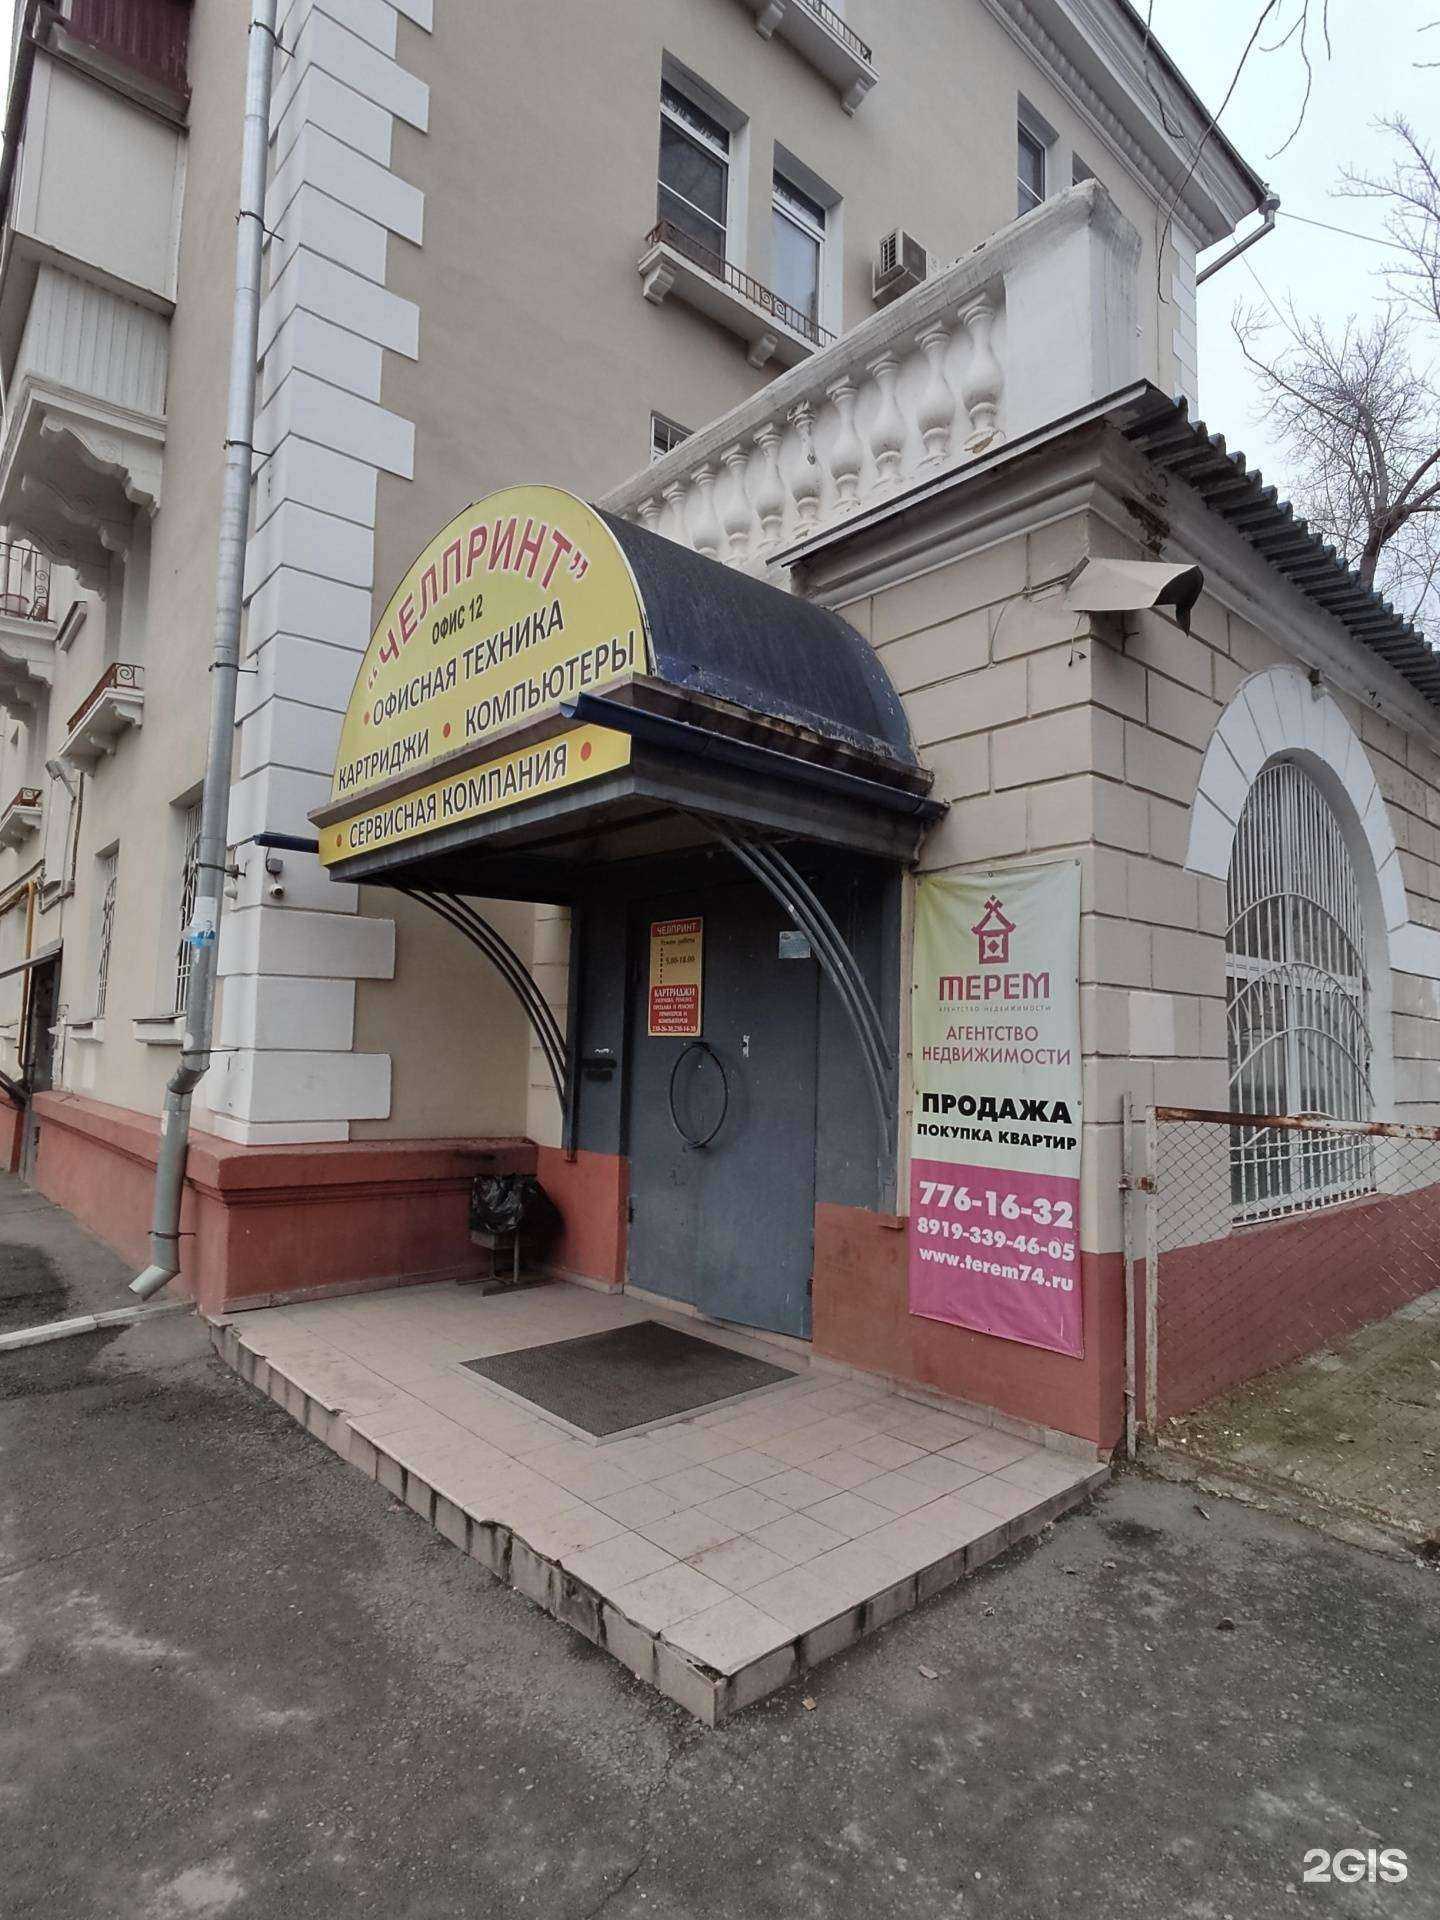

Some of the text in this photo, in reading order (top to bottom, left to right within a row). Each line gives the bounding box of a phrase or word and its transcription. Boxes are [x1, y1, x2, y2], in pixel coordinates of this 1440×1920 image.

[431, 593, 484, 646] ОФИС 12
[372, 599, 565, 728] ОФИСНАЯ ТЕХНИКА
[464, 629, 635, 738] КОМПЬЮТЕРЫ
[338, 728, 430, 792] КАРТРИДЖИ
[348, 742, 568, 850] СЕРВИСНАЯ КОМПАНИЯ
[654, 987, 696, 998] КАРТРИДЖИ
[939, 972, 1050, 1001] ТЕРЕМ
[922, 1046, 1071, 1065] НЕДВИЖИМОСТИ
[946, 1025, 1039, 1041] АГЕНТСТВО
[921, 1092, 1073, 1124] ПРОДАЖА
[917, 1123, 1077, 1150] ПОКУПКА КВАРТИР
[919, 1181, 1074, 1229] 776-16-32
[916, 1216, 1076, 1262] 8919-339-46-05
[918, 1247, 1074, 1291] www.terem74.ru
